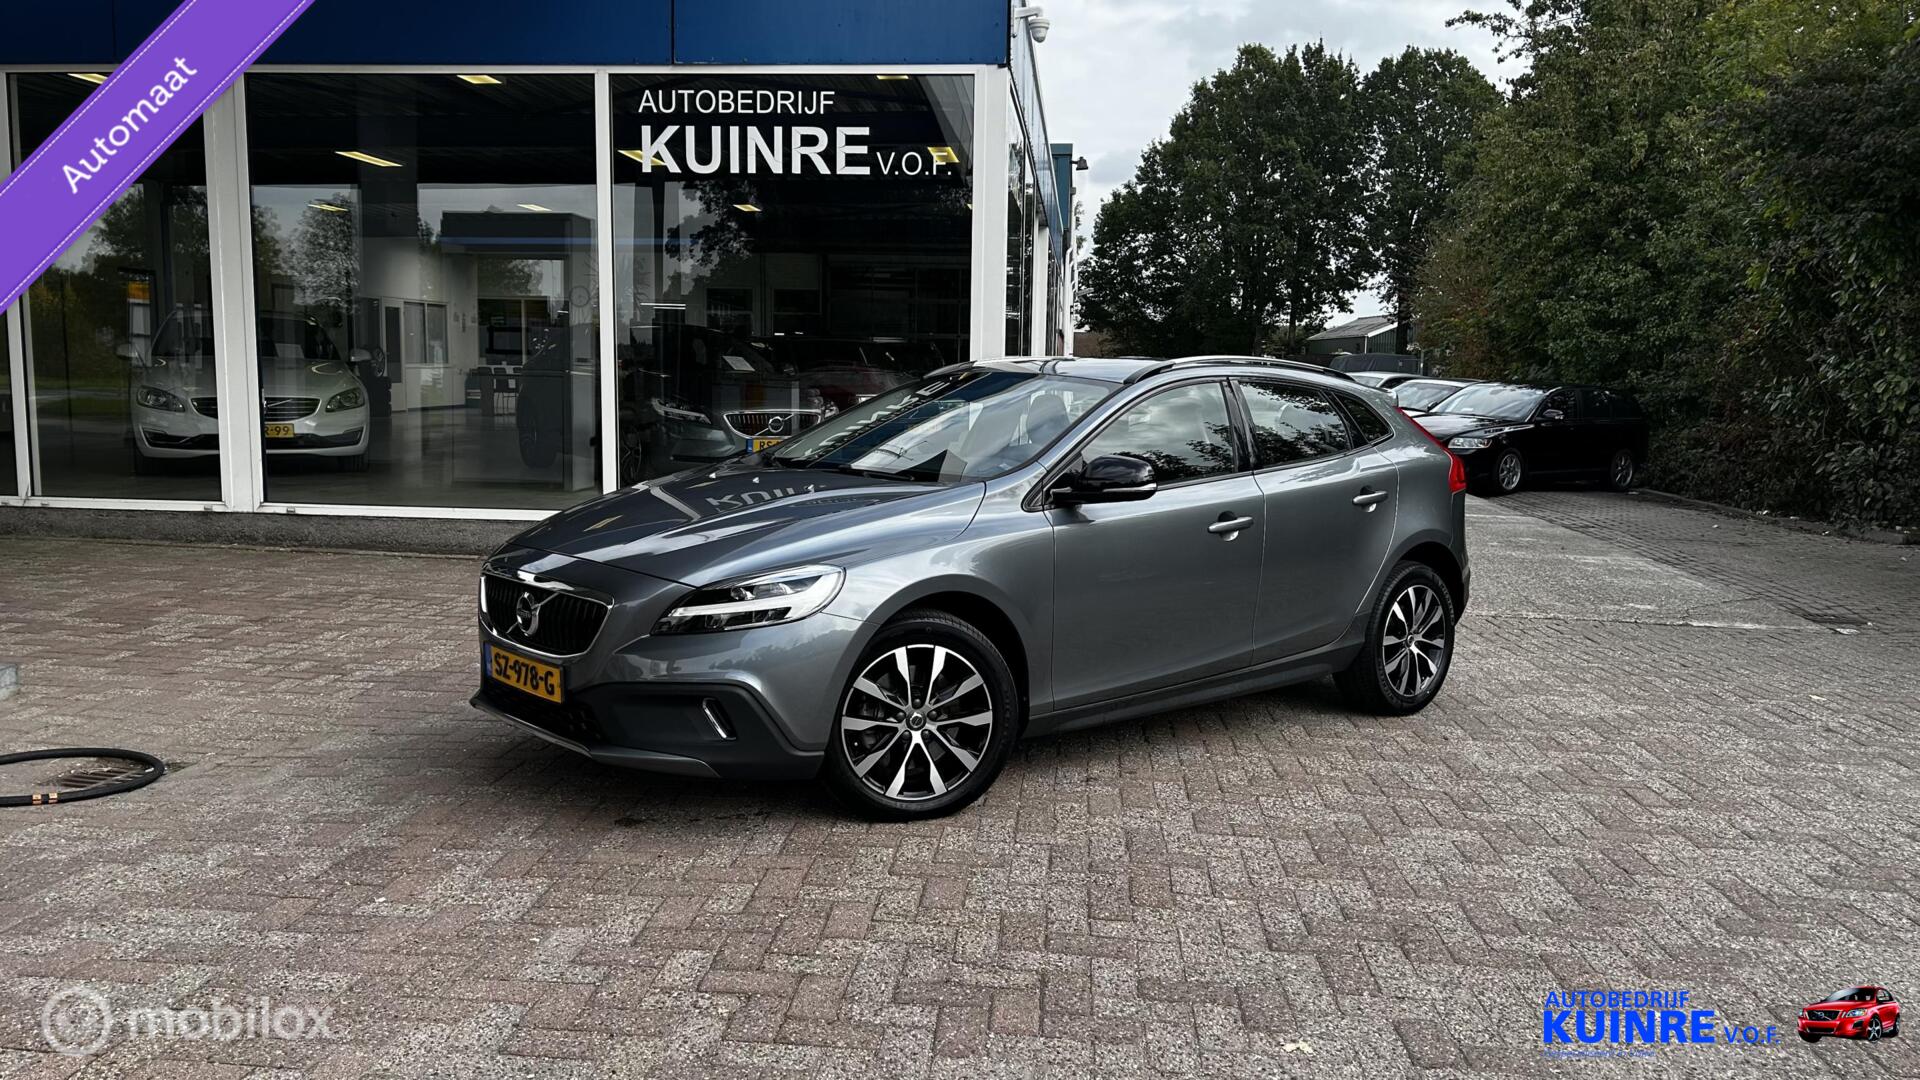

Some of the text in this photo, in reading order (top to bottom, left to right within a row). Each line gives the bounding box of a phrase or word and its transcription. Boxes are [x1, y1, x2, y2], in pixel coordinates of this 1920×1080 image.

[638, 89, 835, 115] AUTOBEDRIJF
[641, 124, 952, 176] KUINRE V.O.F.
[494, 652, 556, 696] SZ-978-G
